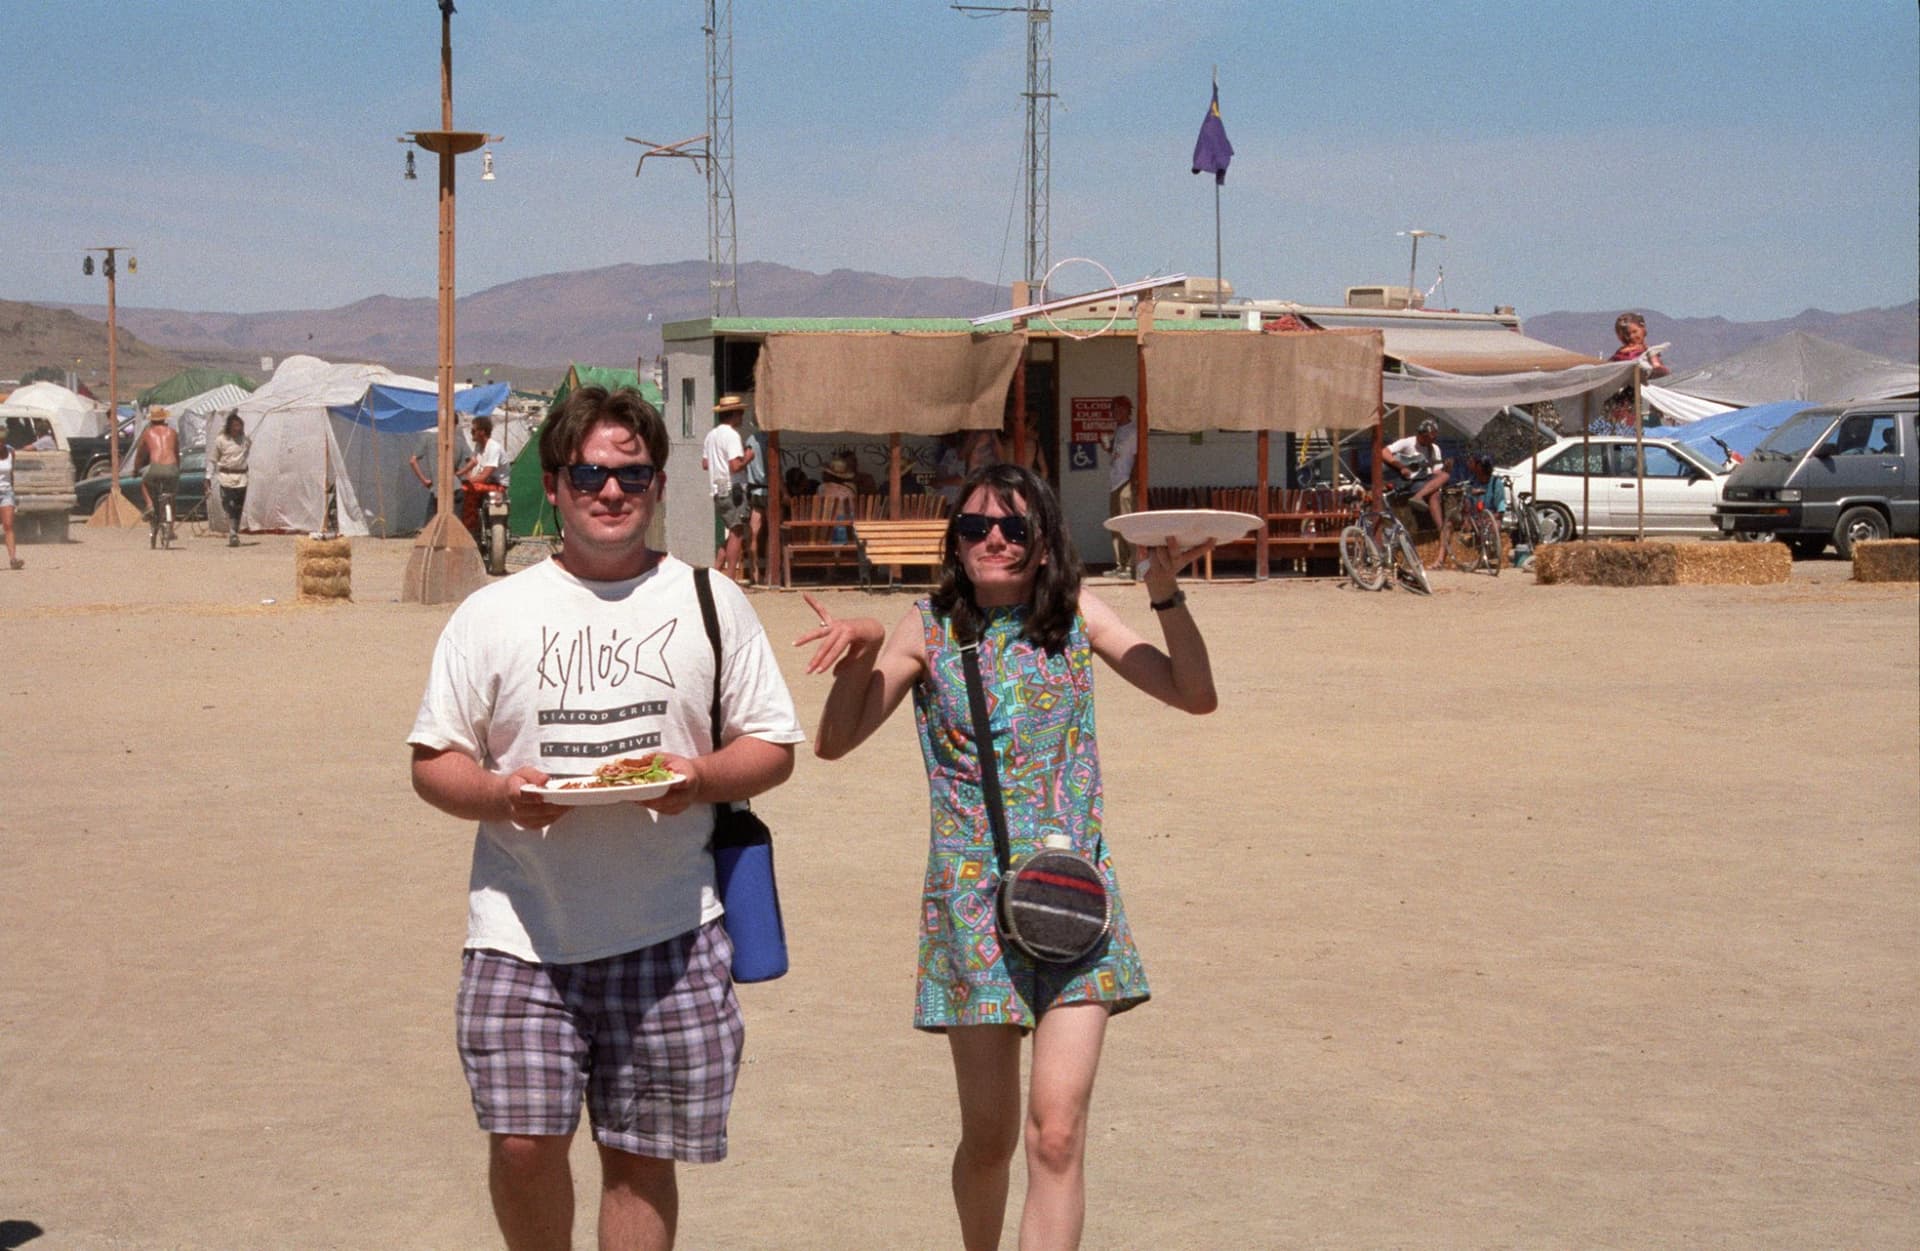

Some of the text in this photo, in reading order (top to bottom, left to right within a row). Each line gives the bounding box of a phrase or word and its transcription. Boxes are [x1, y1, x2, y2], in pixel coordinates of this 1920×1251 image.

[542, 703, 663, 721] SEAFOOD GRILL
[563, 744, 589, 753] THE
[618, 735, 659, 750] RIVER
